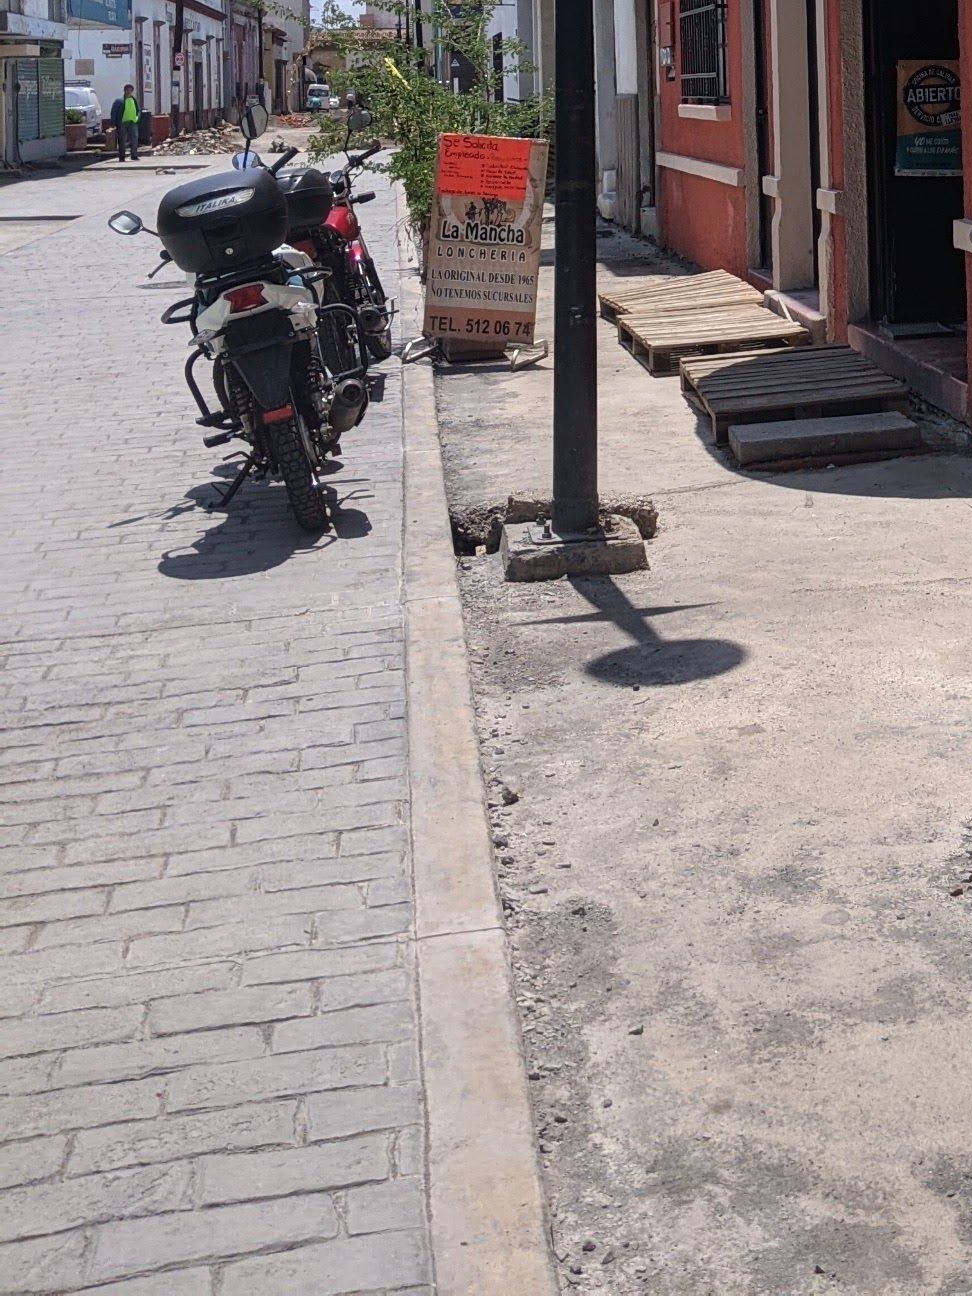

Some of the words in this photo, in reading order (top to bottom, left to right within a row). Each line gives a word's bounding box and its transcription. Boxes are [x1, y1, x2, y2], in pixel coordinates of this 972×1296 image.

[911, 70, 928, 85] COCINA
[936, 68, 956, 84] CALIDAD
[907, 86, 961, 103] ABIERTO
[911, 105, 934, 123] SERVICIO
[444, 136, 459, 149] Se
[463, 137, 498, 152] Solicita
[445, 149, 485, 160] Empleado
[196, 196, 236, 212] ITALIKA
[442, 220, 459, 239] La
[466, 222, 524, 244] Mancha
[437, 246, 526, 262] LONCHERIA
[432, 268, 444, 280] LA
[445, 270, 486, 283] ORIGINAL
[488, 272, 516, 284] DESDE
[518, 274, 534, 286] 1965
[431, 285, 442, 298] NO
[443, 287, 482, 300] TENEMOS
[483, 289, 533, 304] SUCURSALES
[430, 316, 461, 332] TEL.
[466, 318, 490, 334] 512
[494, 320, 510, 335] 06
[514, 321, 530, 336] 74
